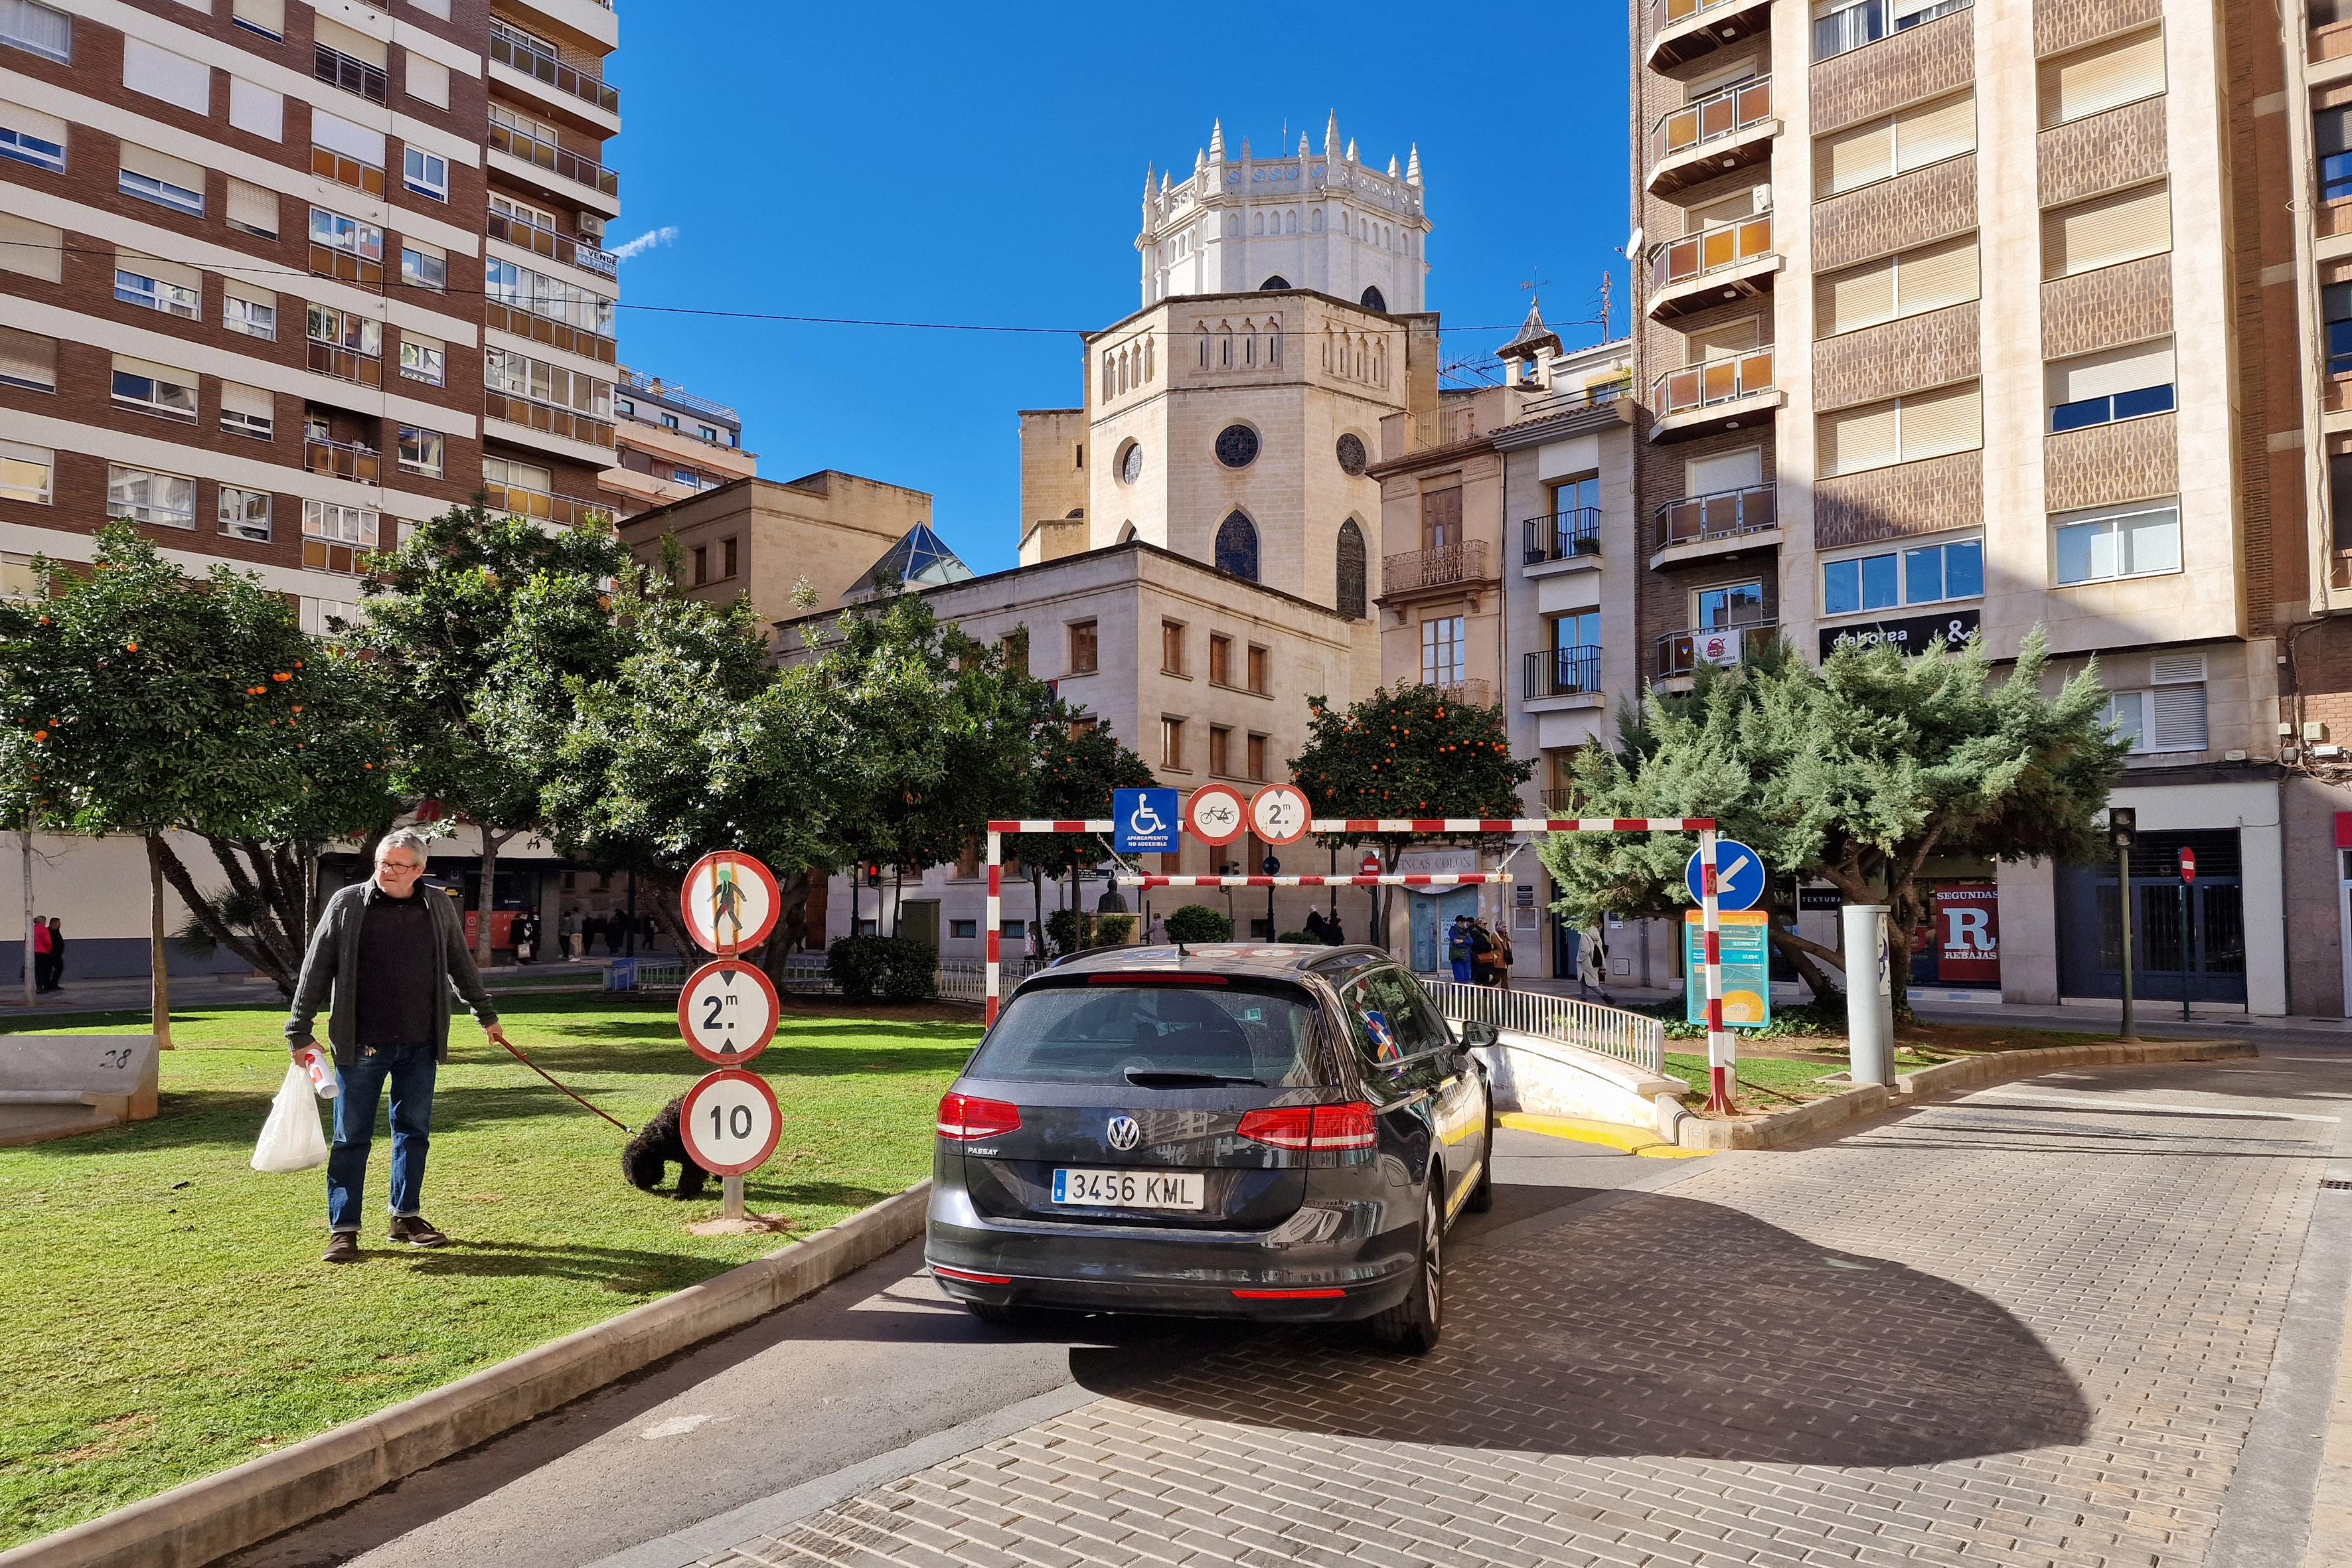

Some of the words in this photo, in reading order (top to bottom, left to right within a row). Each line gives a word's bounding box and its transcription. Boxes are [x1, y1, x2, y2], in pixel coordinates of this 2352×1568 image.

[588, 250, 617, 266] VENDE
[1435, 856, 1471, 869] COLON
[1936, 891, 1998, 900] SEGUNDAS
[1942, 907, 1996, 951] R
[100, 1048, 132, 1069] 28
[710, 1105, 752, 1140] 10
[968, 1147, 999, 1156] PASSAT
[1057, 1188, 1062, 1197] E
[1072, 1174, 1135, 1202] 3456
[1146, 1177, 1194, 1205] KML
